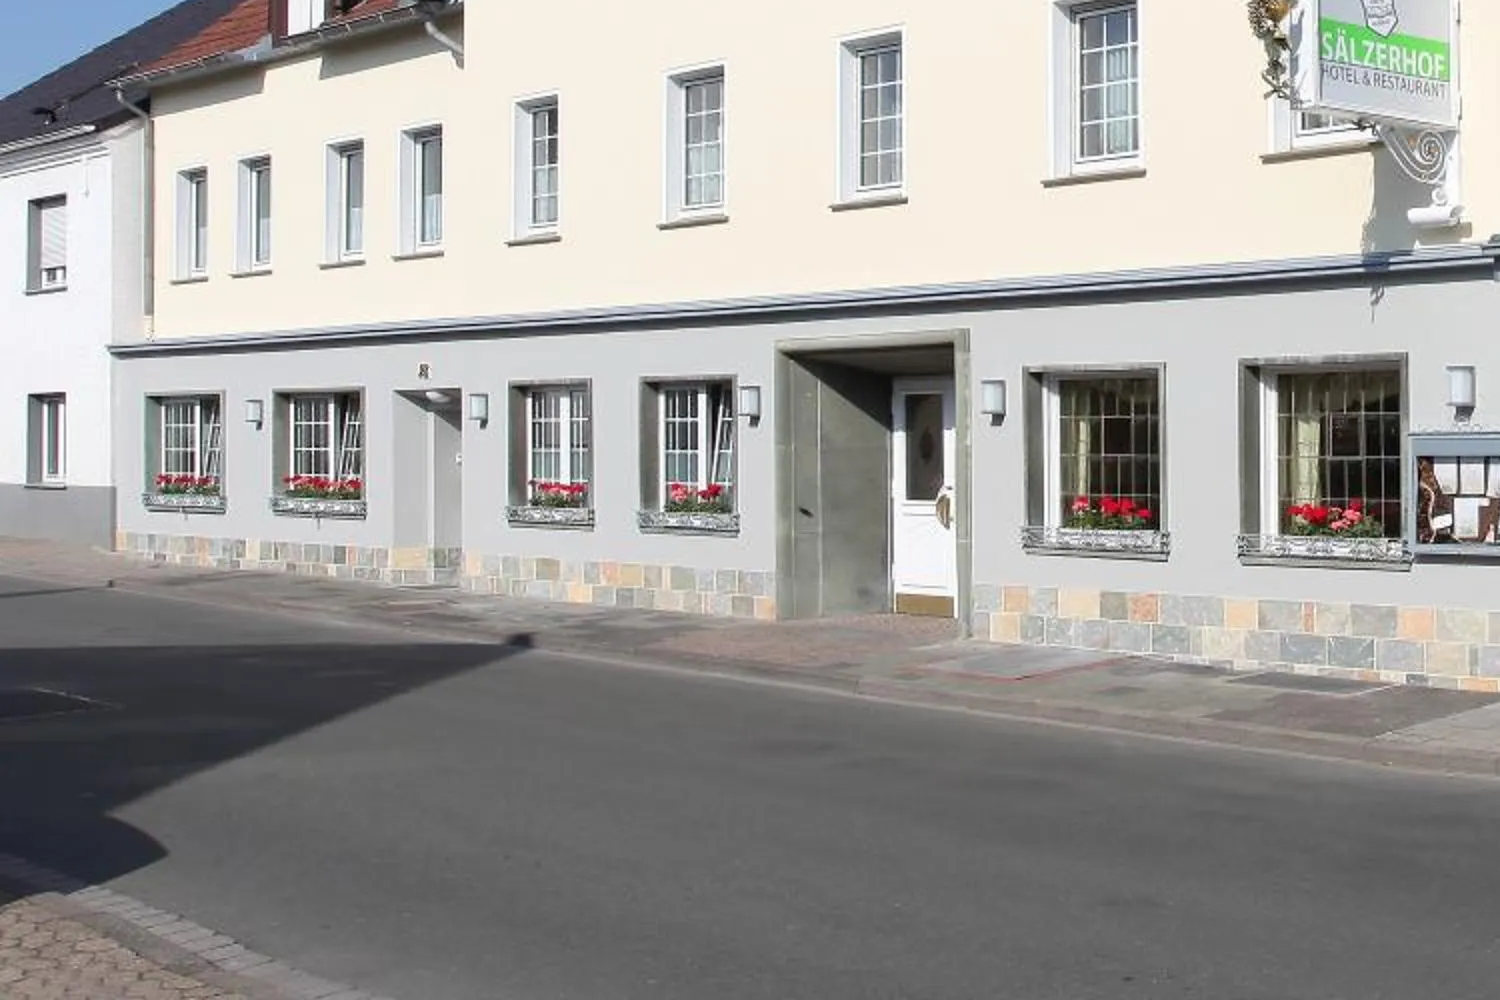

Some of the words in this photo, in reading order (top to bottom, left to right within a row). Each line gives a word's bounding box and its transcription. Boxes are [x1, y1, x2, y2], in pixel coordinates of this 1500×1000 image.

[1321, 27, 1446, 78] SÄLZERHOF
[1320, 62, 1360, 85] HOTEL
[1361, 69, 1371, 87] &
[1373, 71, 1446, 99] RESTAURANT
